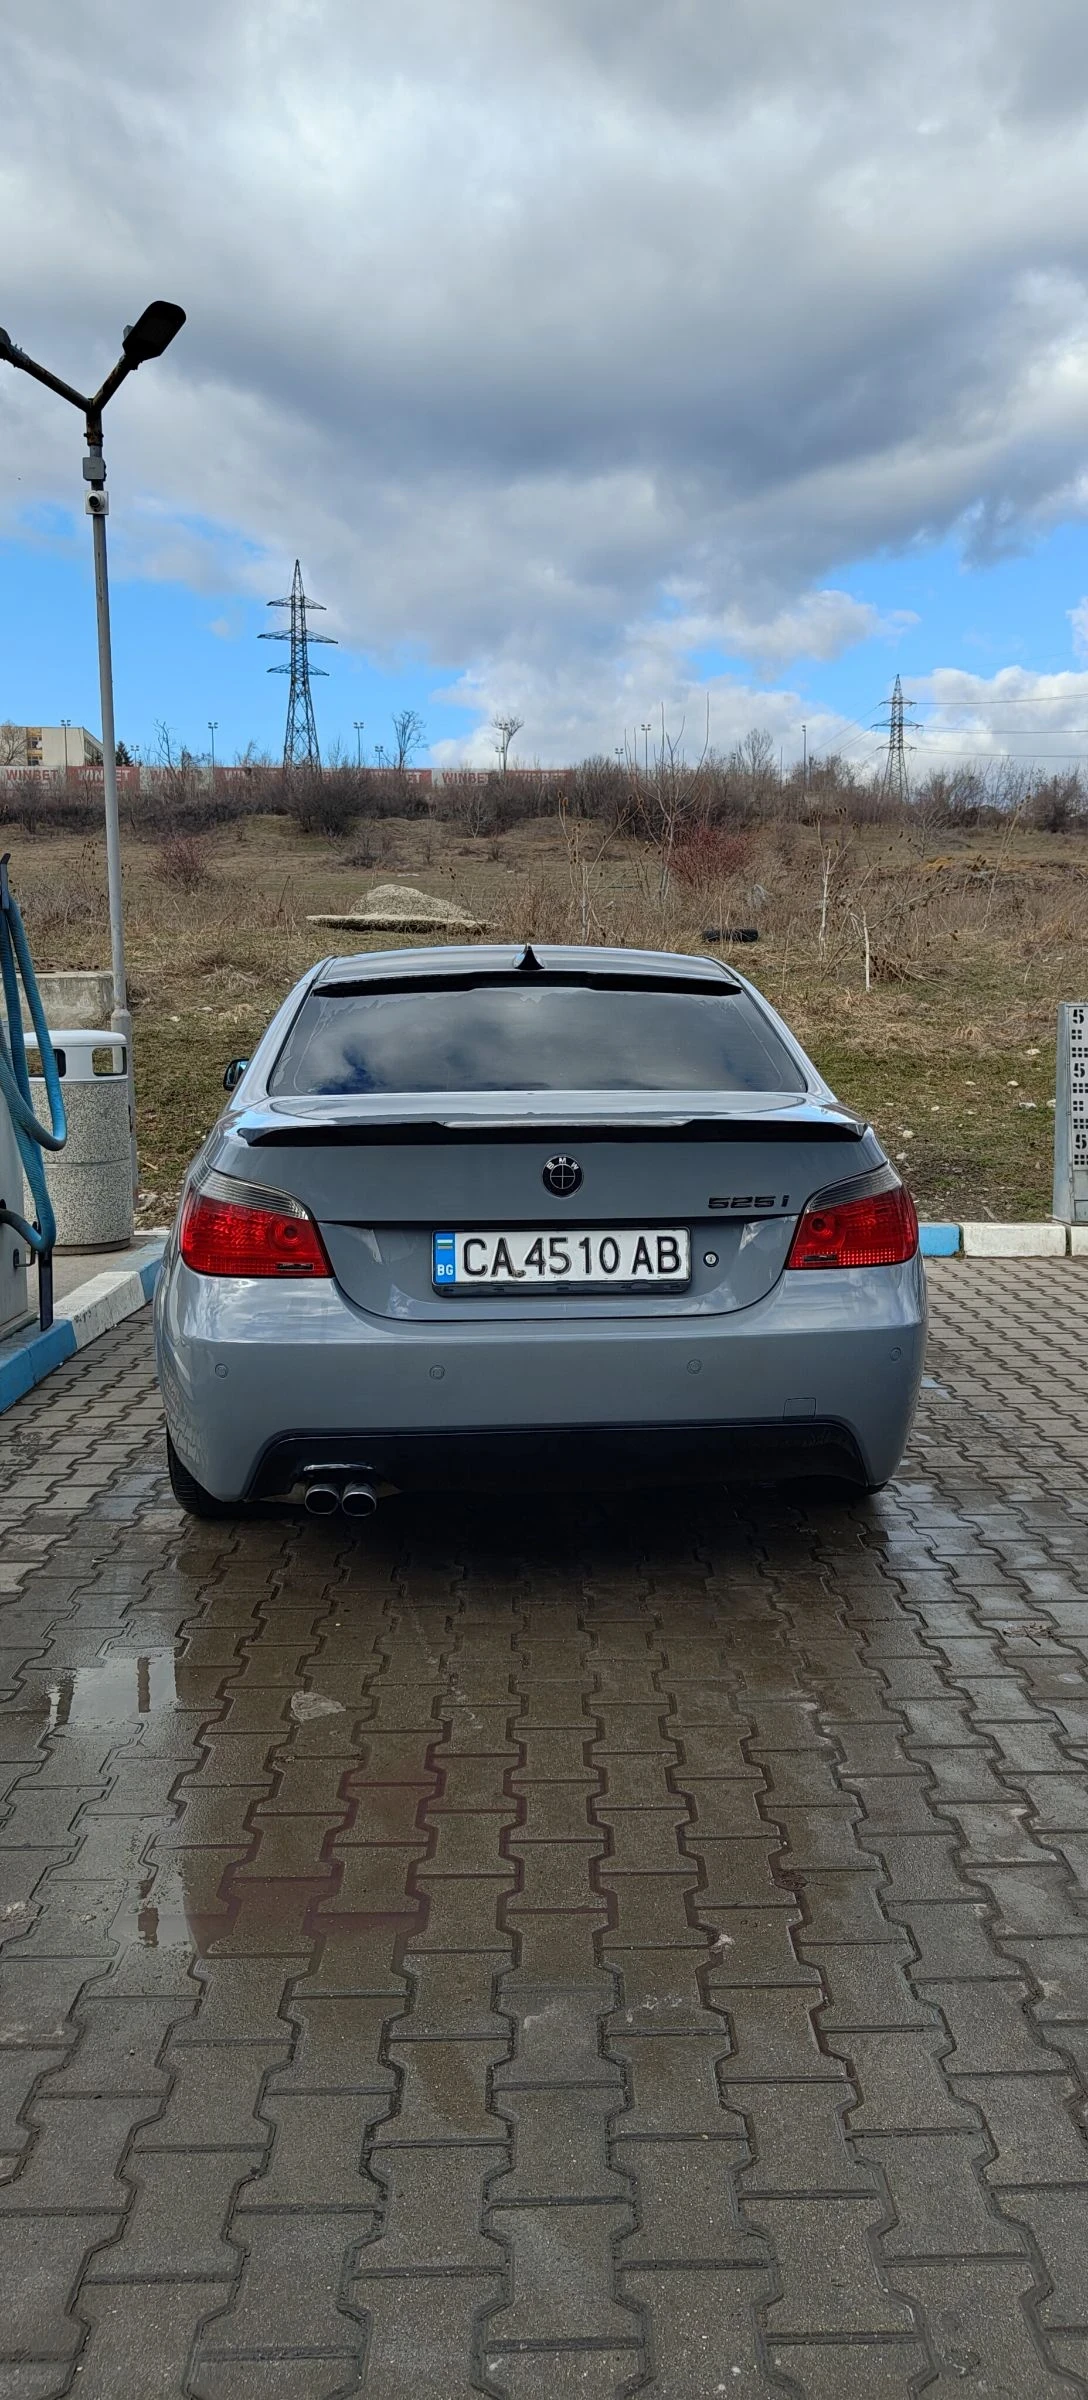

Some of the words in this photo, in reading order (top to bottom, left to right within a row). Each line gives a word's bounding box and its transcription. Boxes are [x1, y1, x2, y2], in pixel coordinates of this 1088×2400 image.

[5, 769, 59, 781] WINBET
[78, 769, 131, 782] WINET
[546, 1157, 580, 1170] BMW
[437, 1264, 454, 1277] BG
